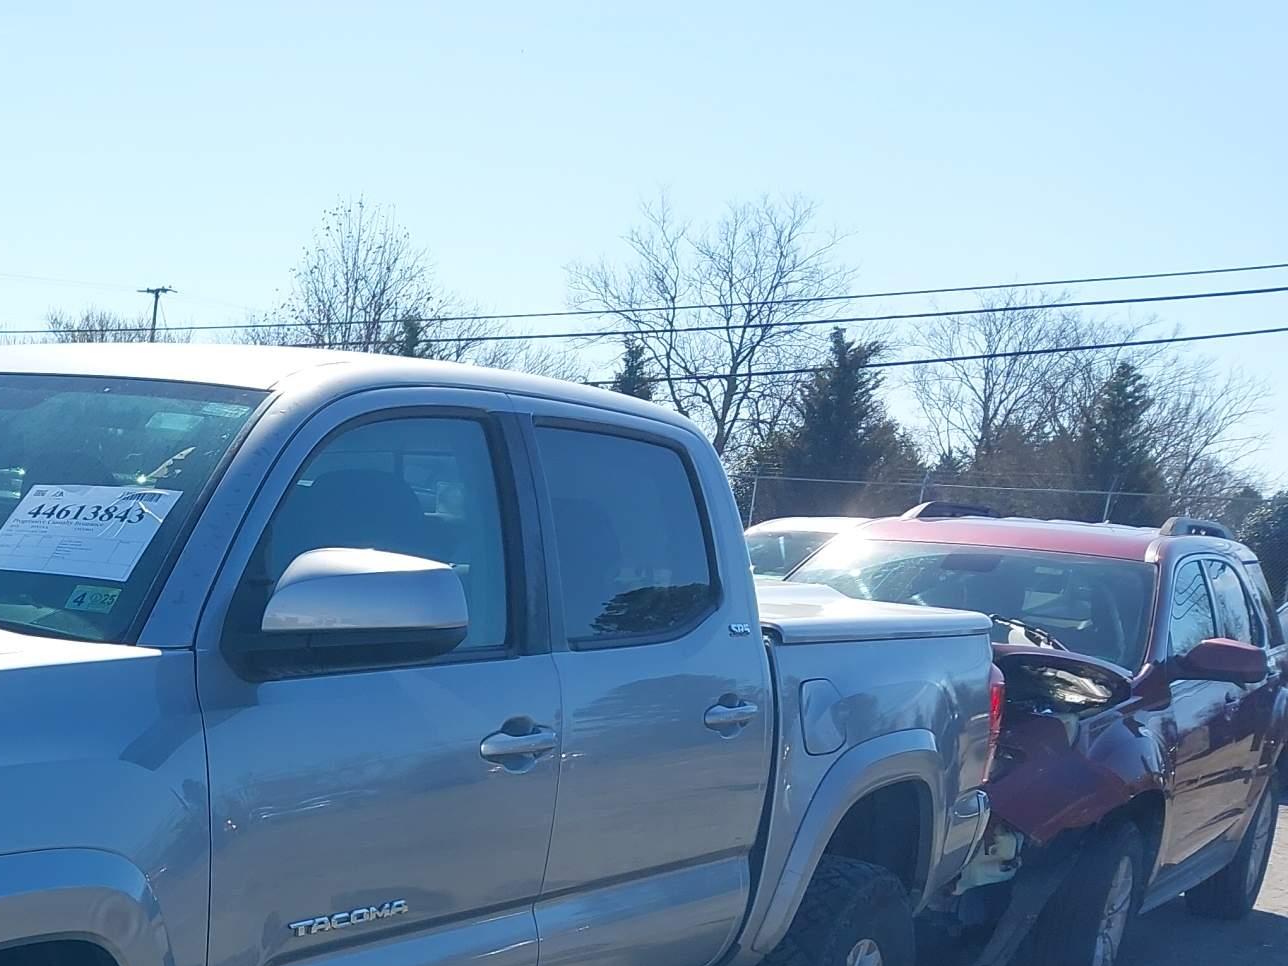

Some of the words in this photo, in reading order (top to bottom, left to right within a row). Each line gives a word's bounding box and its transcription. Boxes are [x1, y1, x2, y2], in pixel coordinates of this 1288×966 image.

[28, 503, 145, 524] 44613843
[73, 592, 87, 606] 4
[288, 898, 409, 937] TACOMA
